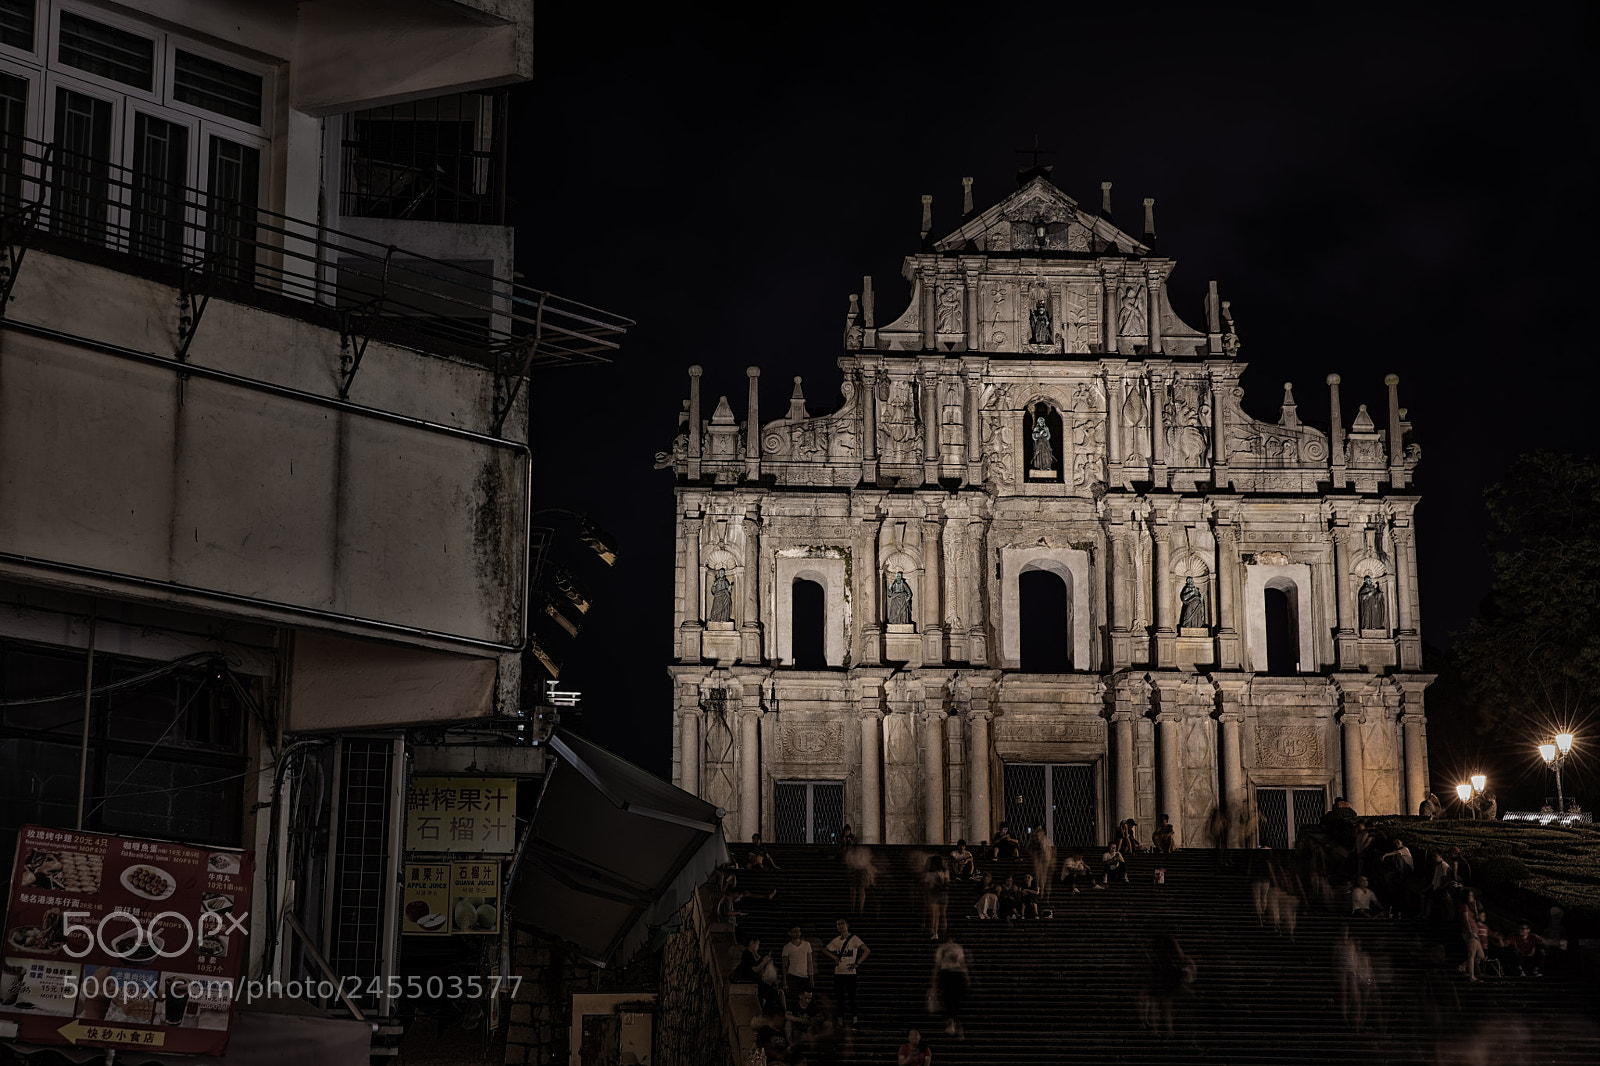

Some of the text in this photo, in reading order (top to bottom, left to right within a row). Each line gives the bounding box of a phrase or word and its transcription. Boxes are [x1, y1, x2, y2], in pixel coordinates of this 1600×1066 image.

[408, 787, 508, 812] 鮮榨果汁
[417, 816, 507, 842] 石榴汁
[459, 866, 492, 879] 石榴汁
